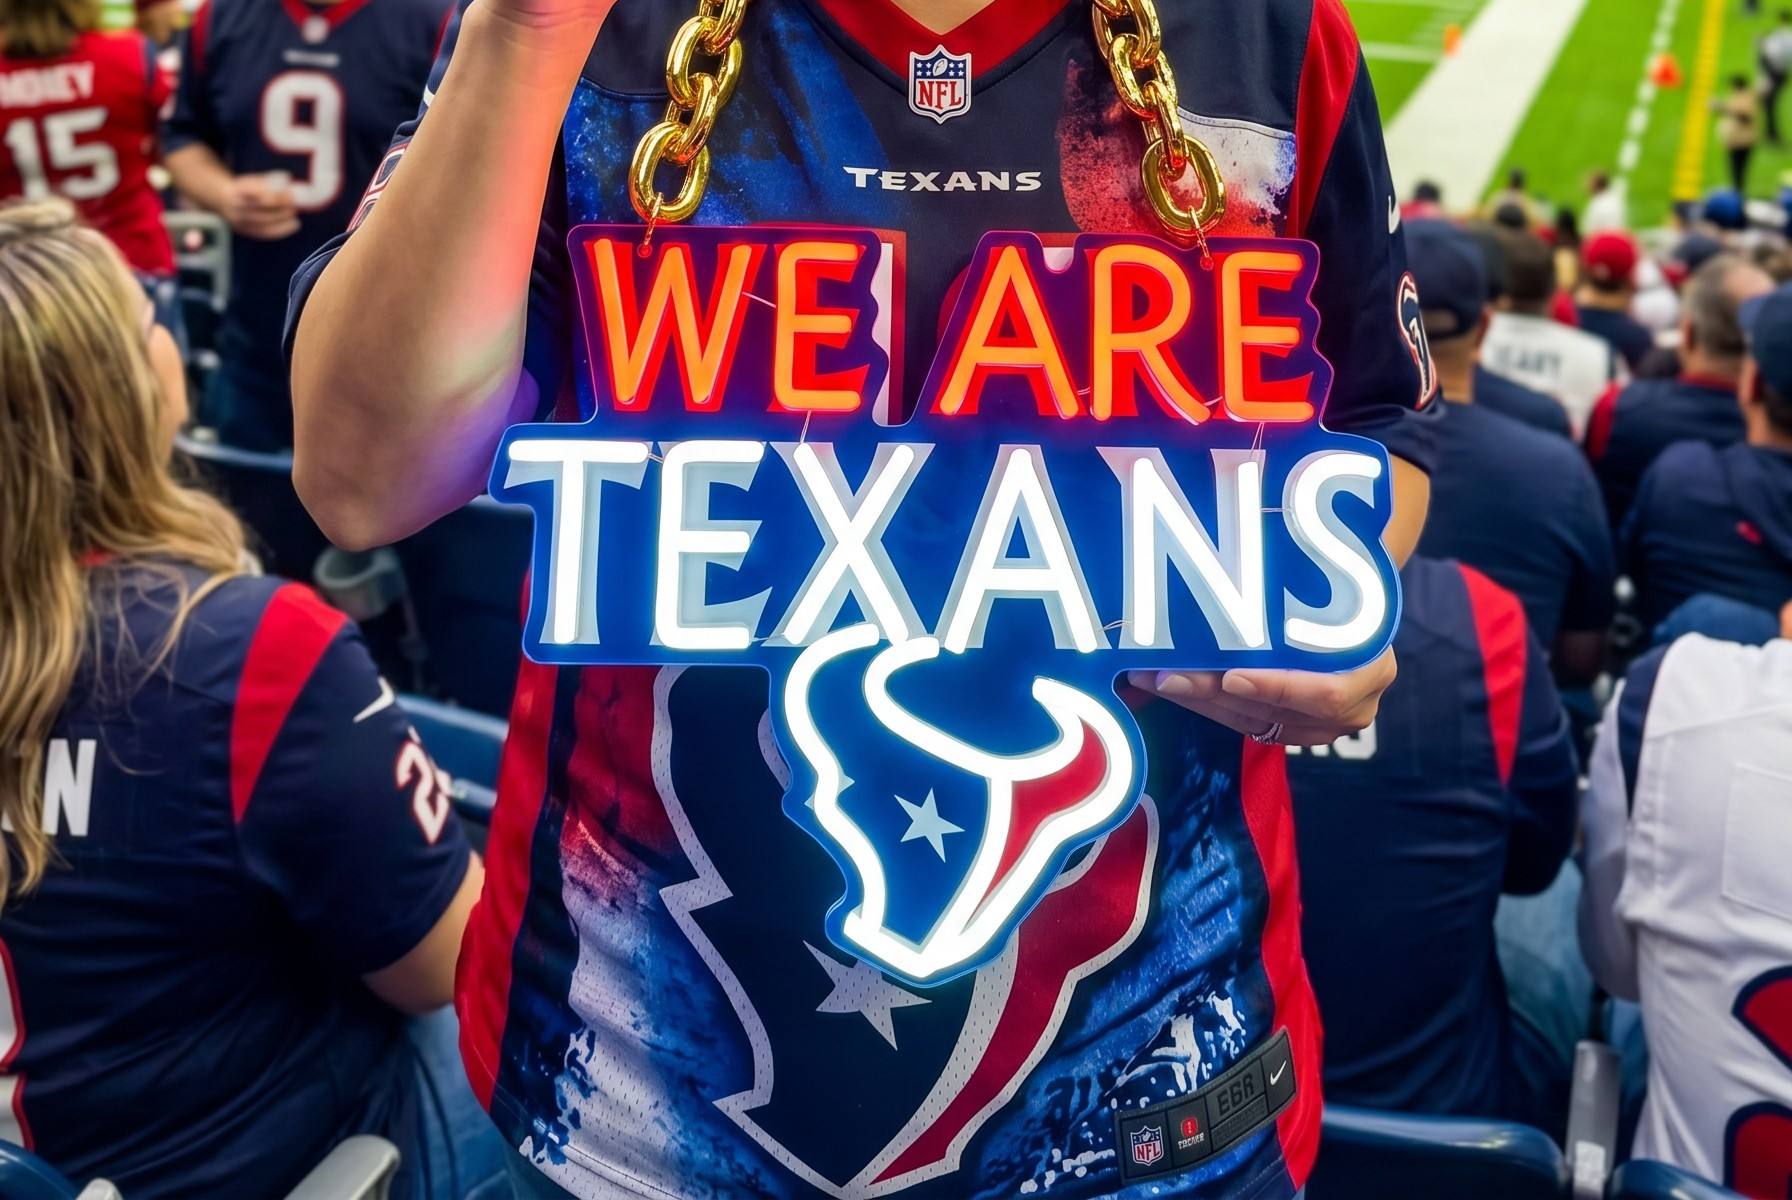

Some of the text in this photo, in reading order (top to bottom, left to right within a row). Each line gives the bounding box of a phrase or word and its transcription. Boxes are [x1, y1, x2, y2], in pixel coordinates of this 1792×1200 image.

[263, 71, 345, 211] 9
[918, 81, 962, 109] NFL
[4, 105, 120, 199] 15
[843, 166, 1042, 192] TEXANS
[588, 238, 1316, 423] WE ARE
[505, 439, 1393, 653] TEXANS
[1135, 1142, 1161, 1161] NFL
